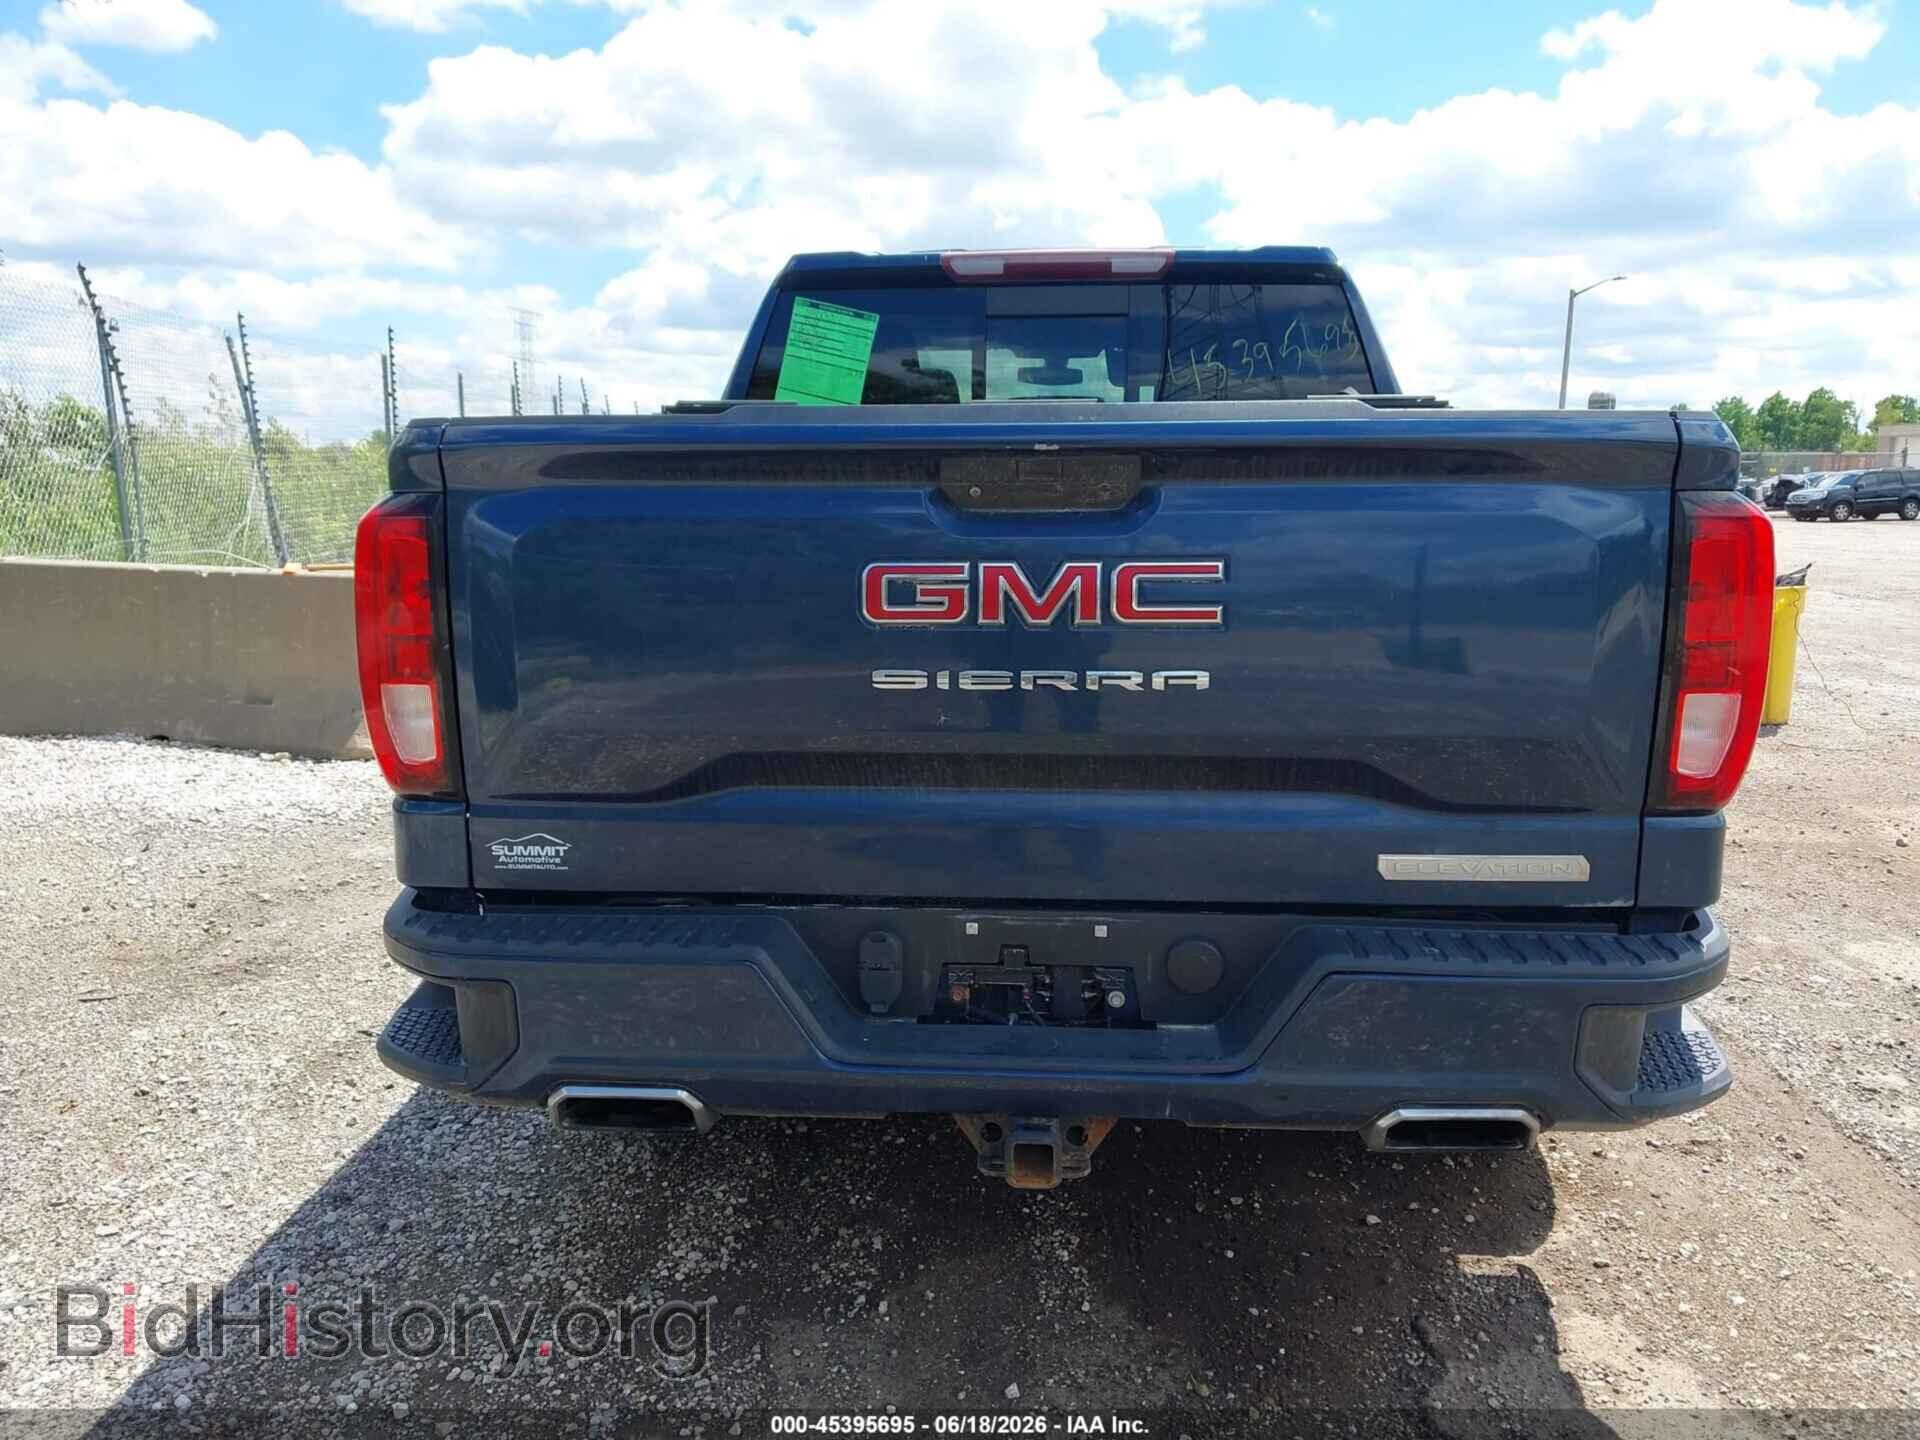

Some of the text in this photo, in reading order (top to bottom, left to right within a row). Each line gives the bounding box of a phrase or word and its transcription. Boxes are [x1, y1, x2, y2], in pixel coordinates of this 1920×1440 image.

[862, 560, 1225, 625] GMC
[871, 669, 1211, 691] SIERRA
[491, 845, 568, 856] SUMMIT
[499, 856, 561, 864] Automotive
[1393, 860, 1572, 877] ELEVATION
